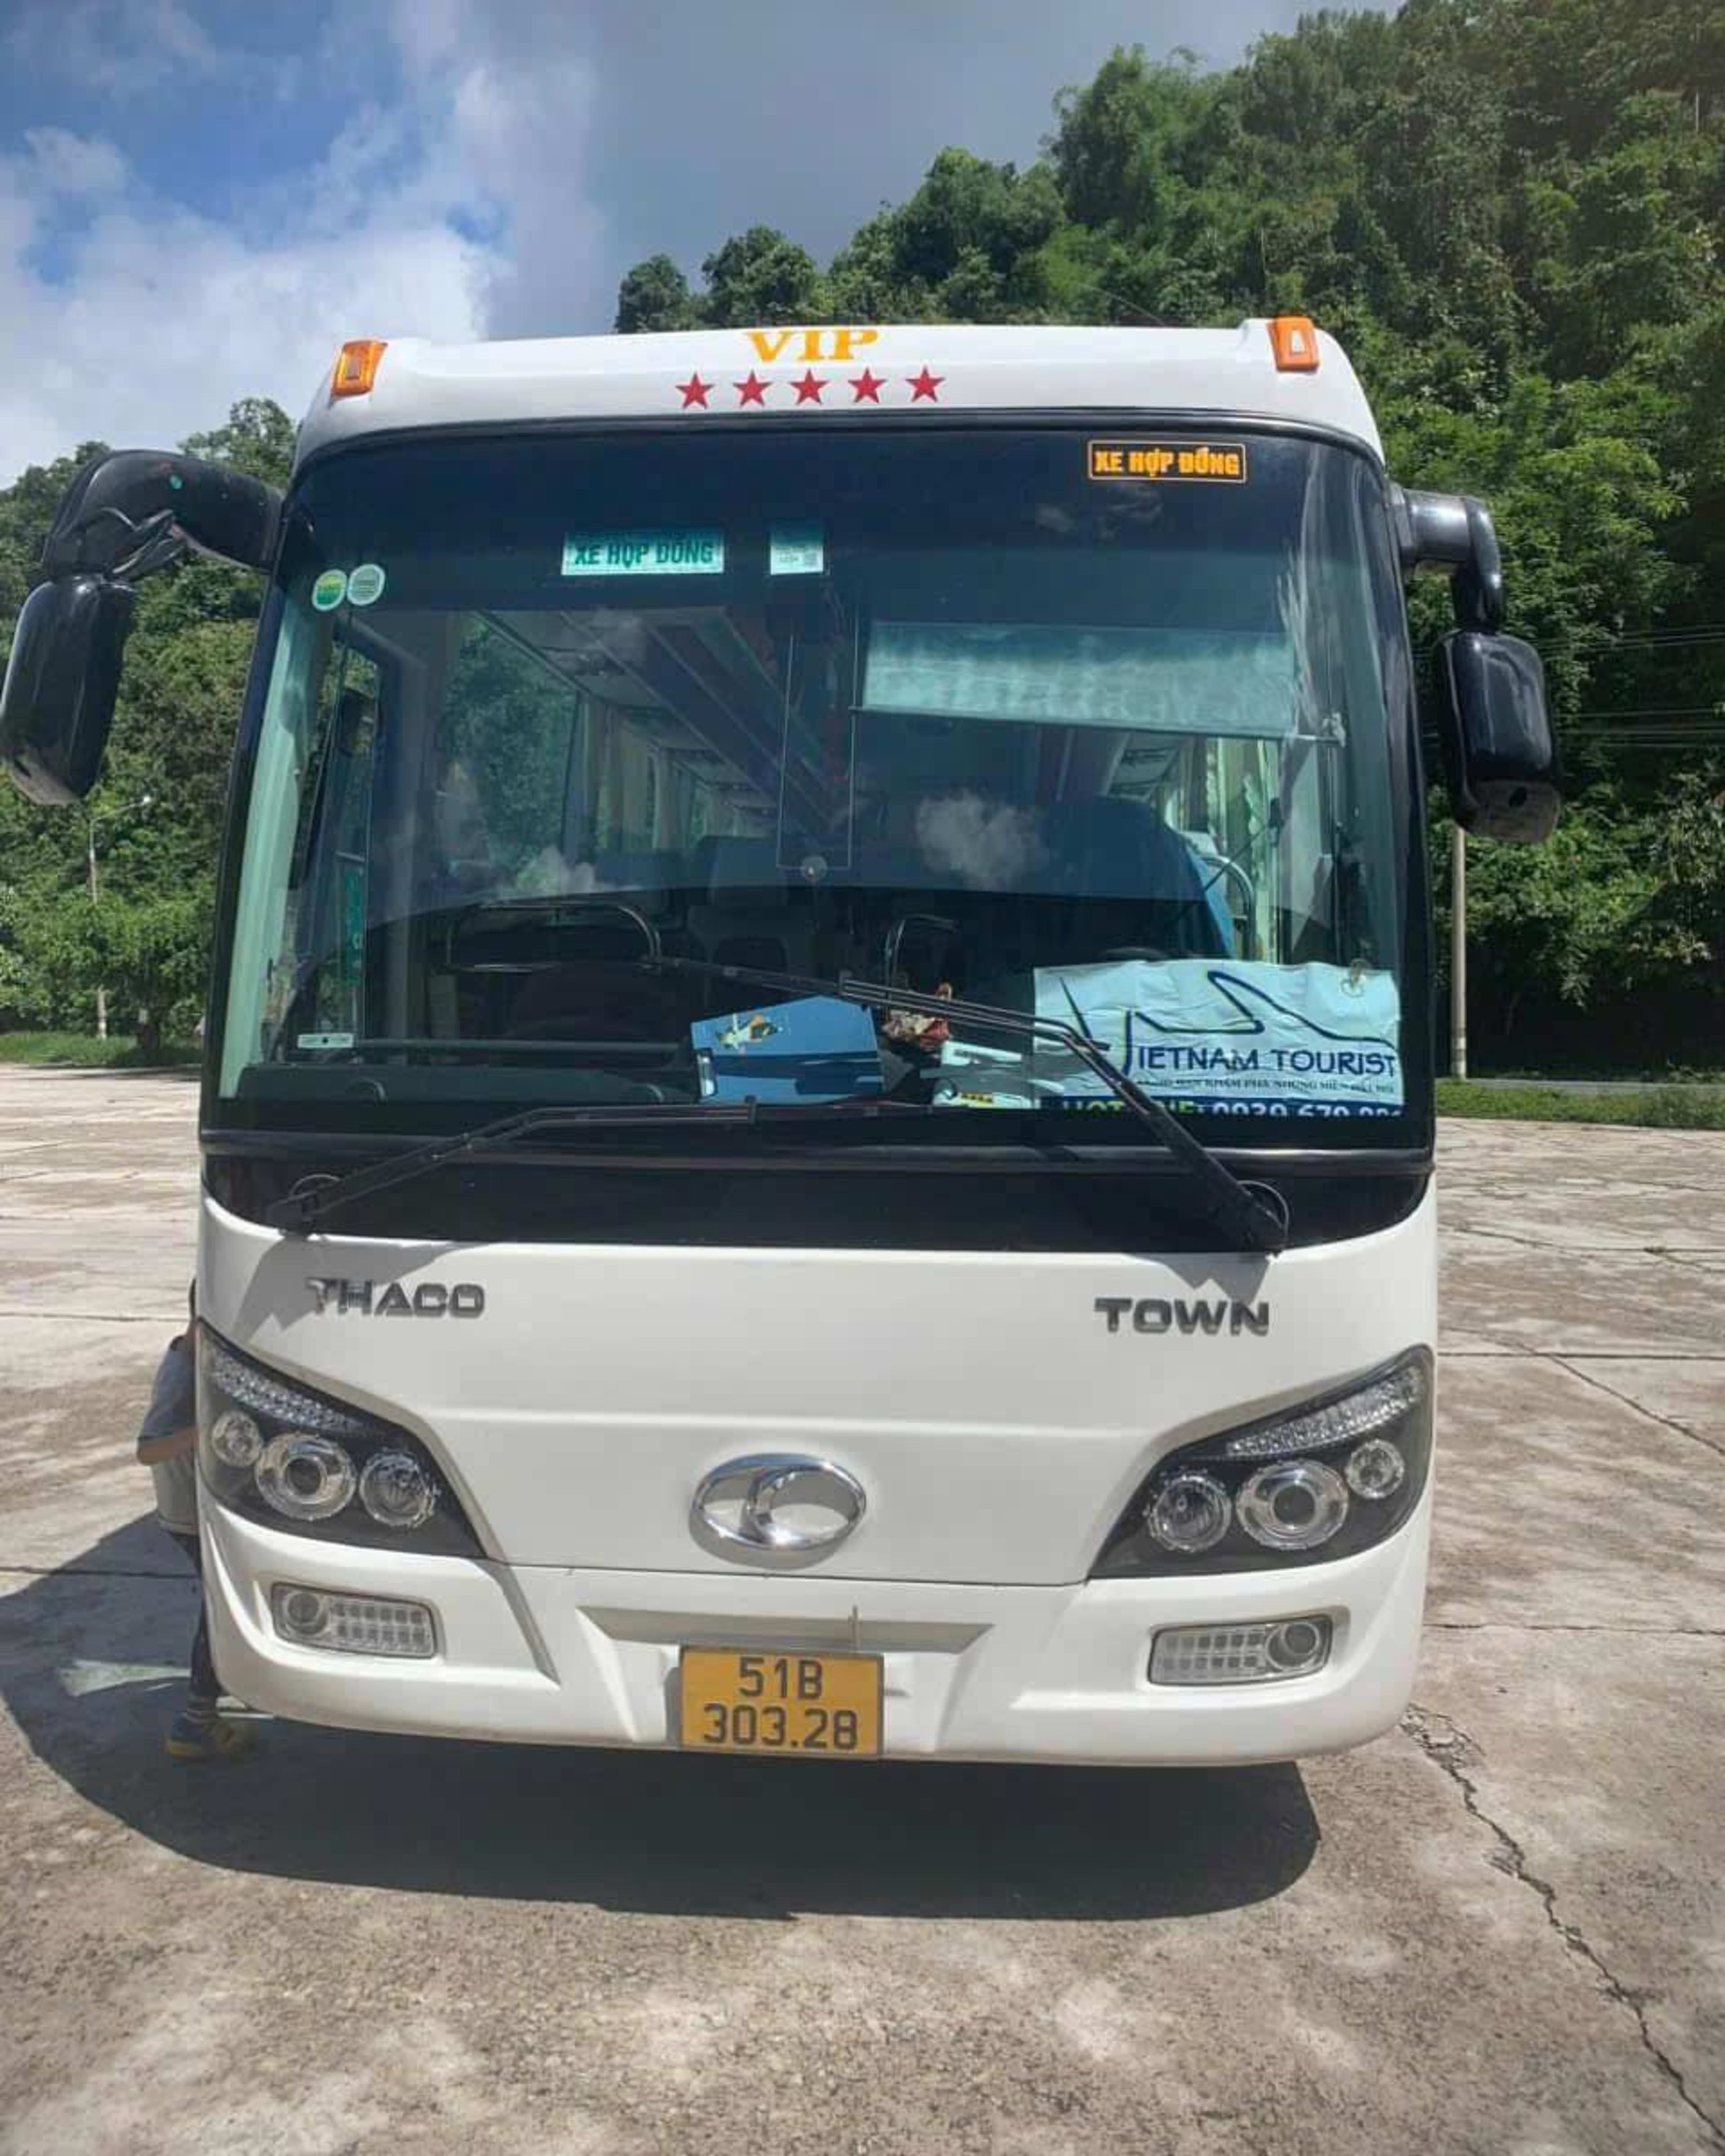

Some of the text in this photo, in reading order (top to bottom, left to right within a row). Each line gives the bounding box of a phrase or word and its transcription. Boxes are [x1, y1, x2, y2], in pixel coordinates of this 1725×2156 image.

[746, 329, 878, 362] VIP
[1094, 451, 1123, 473] XE
[1128, 448, 1174, 477] HỢP
[575, 544, 600, 565] XE
[1269, 1048, 1396, 1078] TOURIST
[305, 1277, 485, 1318] THACO
[1094, 1298, 1269, 1336] TOWN
[739, 1657, 823, 1699] 51B
[704, 1703, 858, 1750] 303.28
